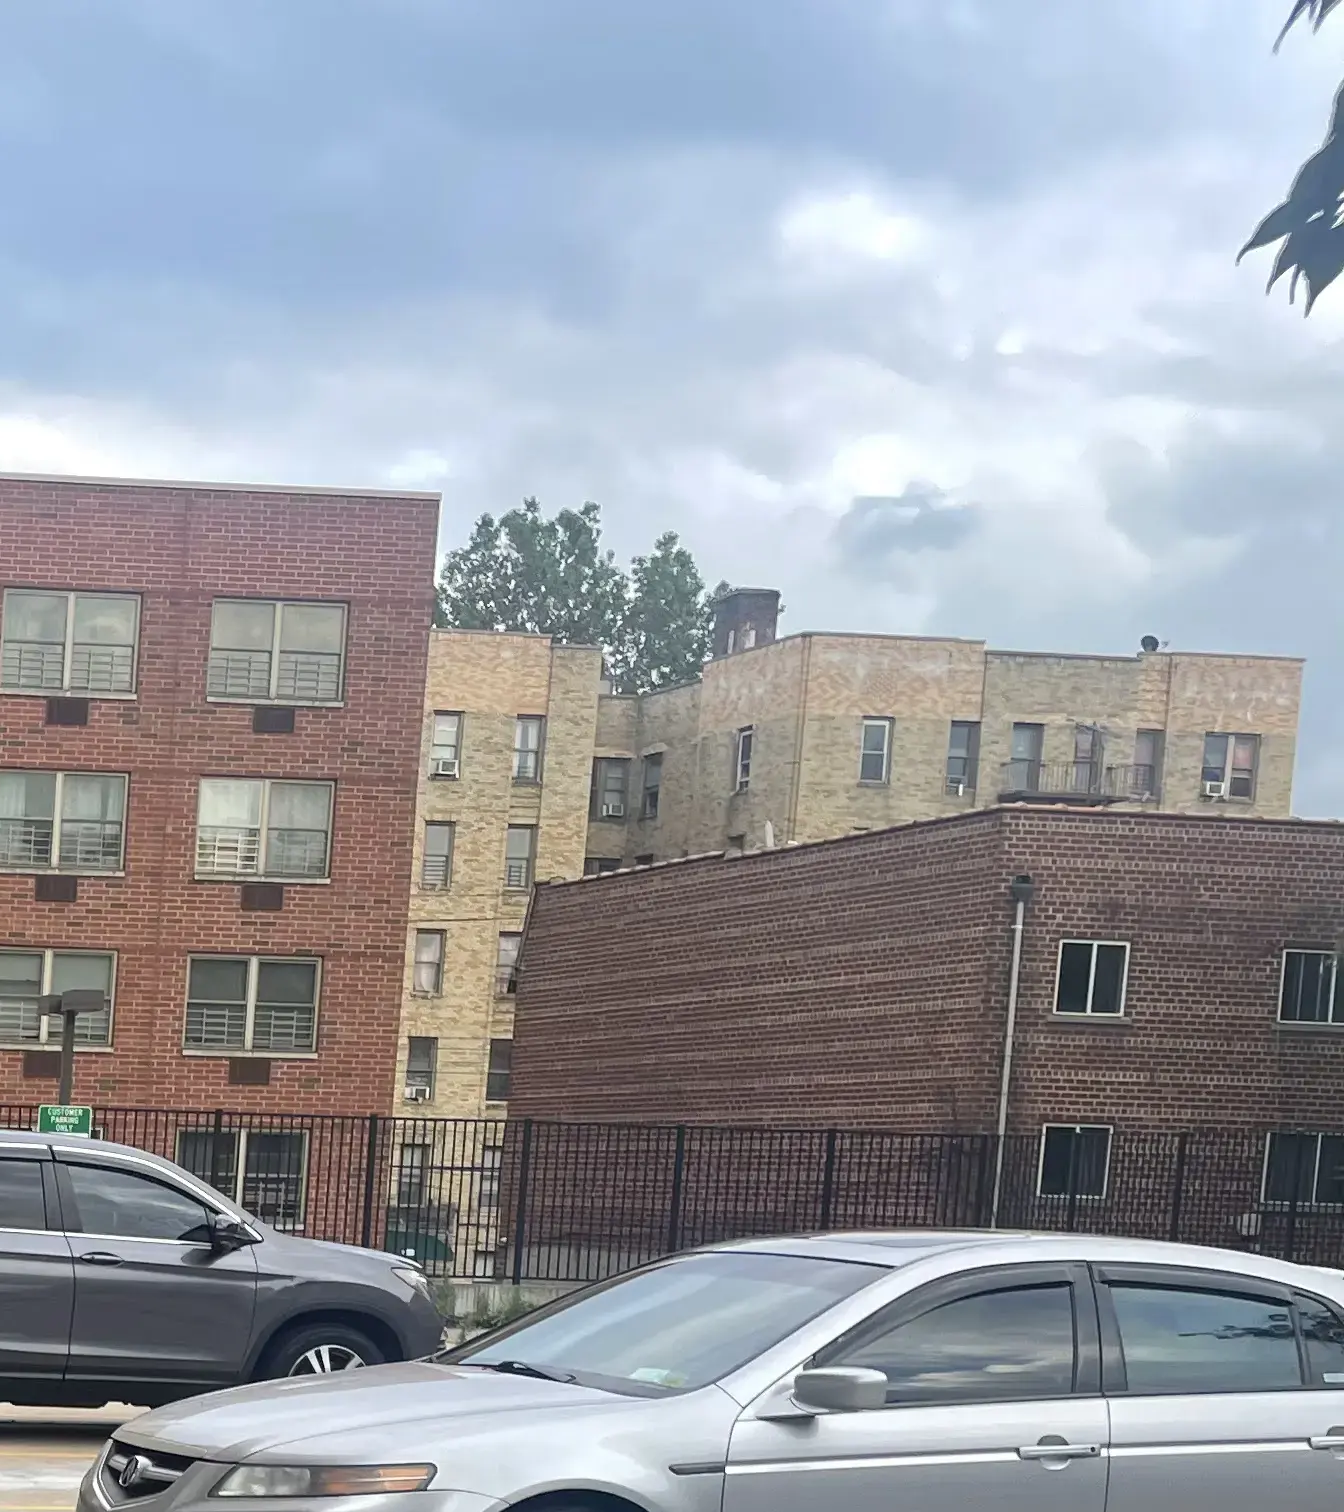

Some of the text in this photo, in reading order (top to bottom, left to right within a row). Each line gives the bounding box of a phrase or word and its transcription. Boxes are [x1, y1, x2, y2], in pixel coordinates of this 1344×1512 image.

[47, 1108, 83, 1116] CUSTOMER
[50, 1116, 79, 1125] PARKING
[55, 1124, 73, 1132] ONLY
